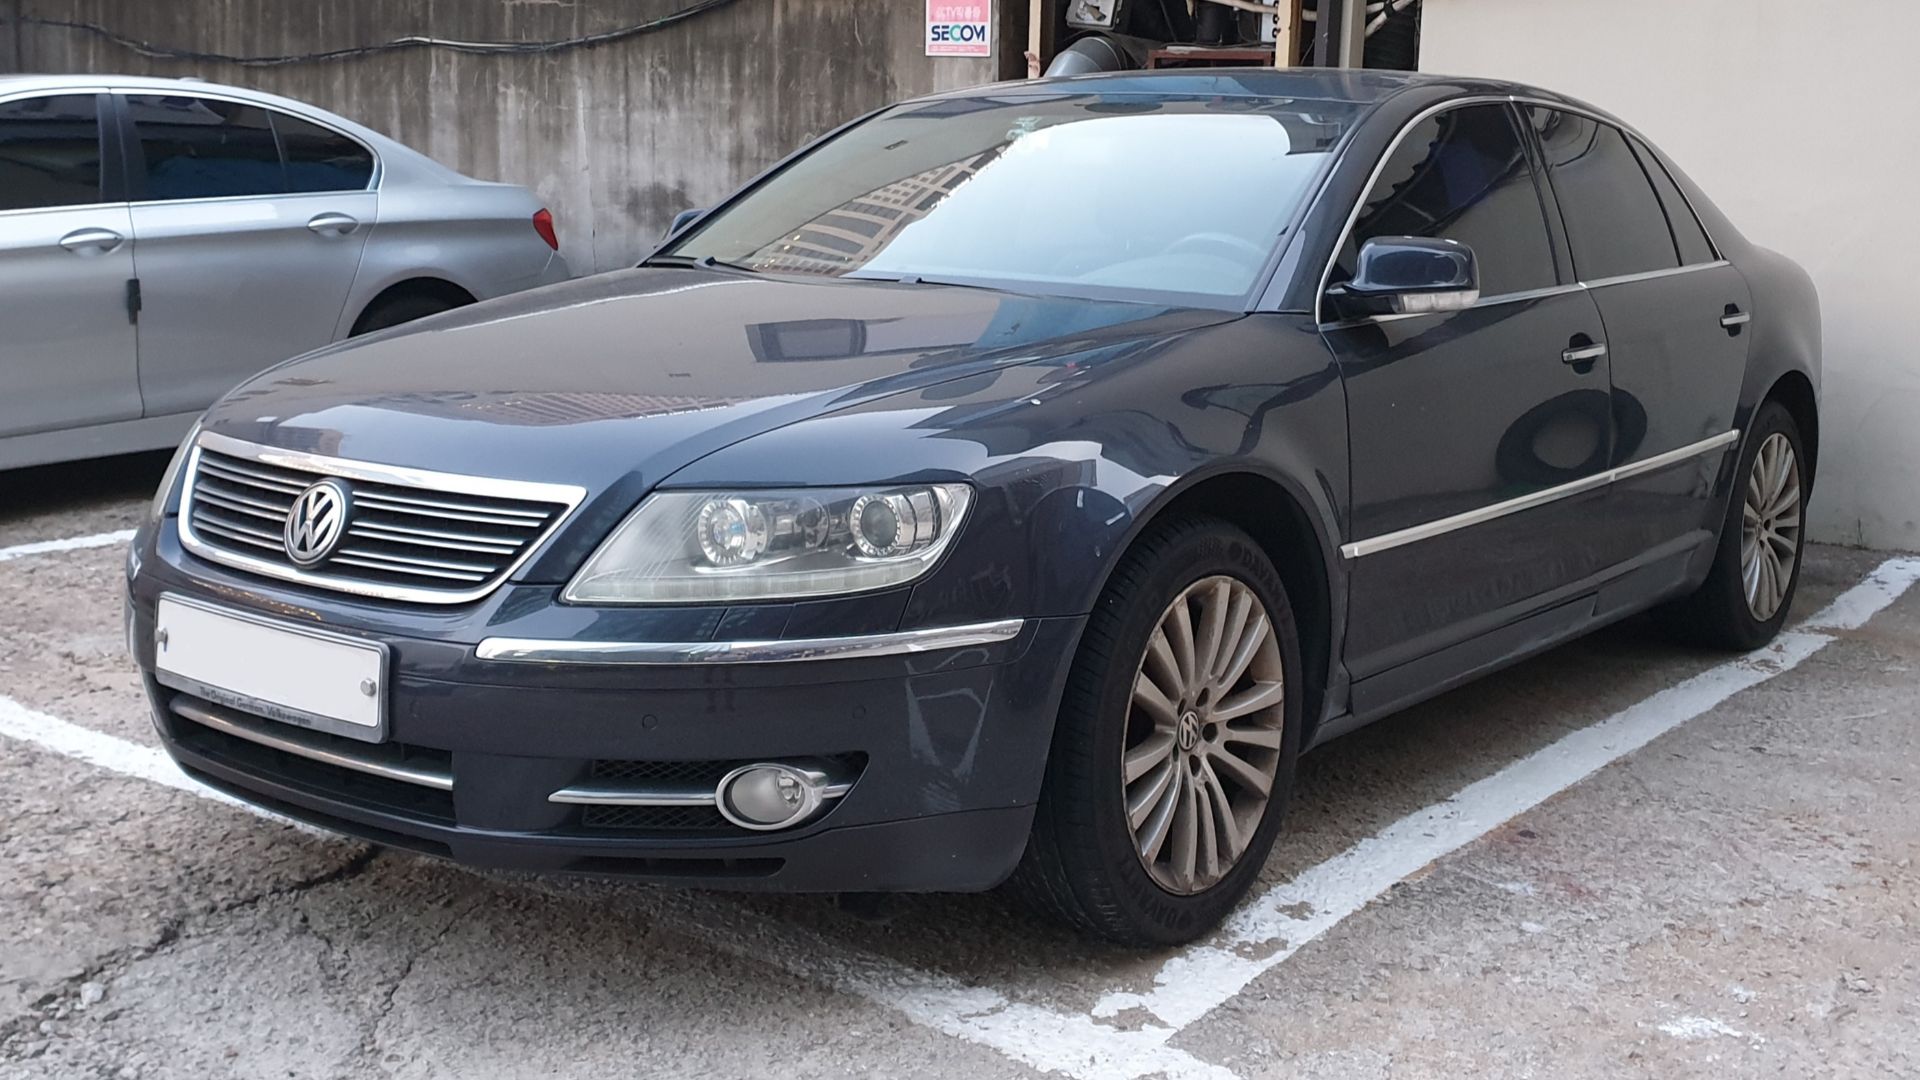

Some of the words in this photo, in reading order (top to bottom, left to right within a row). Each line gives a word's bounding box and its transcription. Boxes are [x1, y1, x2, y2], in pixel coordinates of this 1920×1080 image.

[931, 24, 986, 42] SECOM
[286, 482, 345, 564] VW
[200, 686, 210, 698] The
[210, 689, 236, 706] Original
[265, 704, 312, 727] Volkswagen
